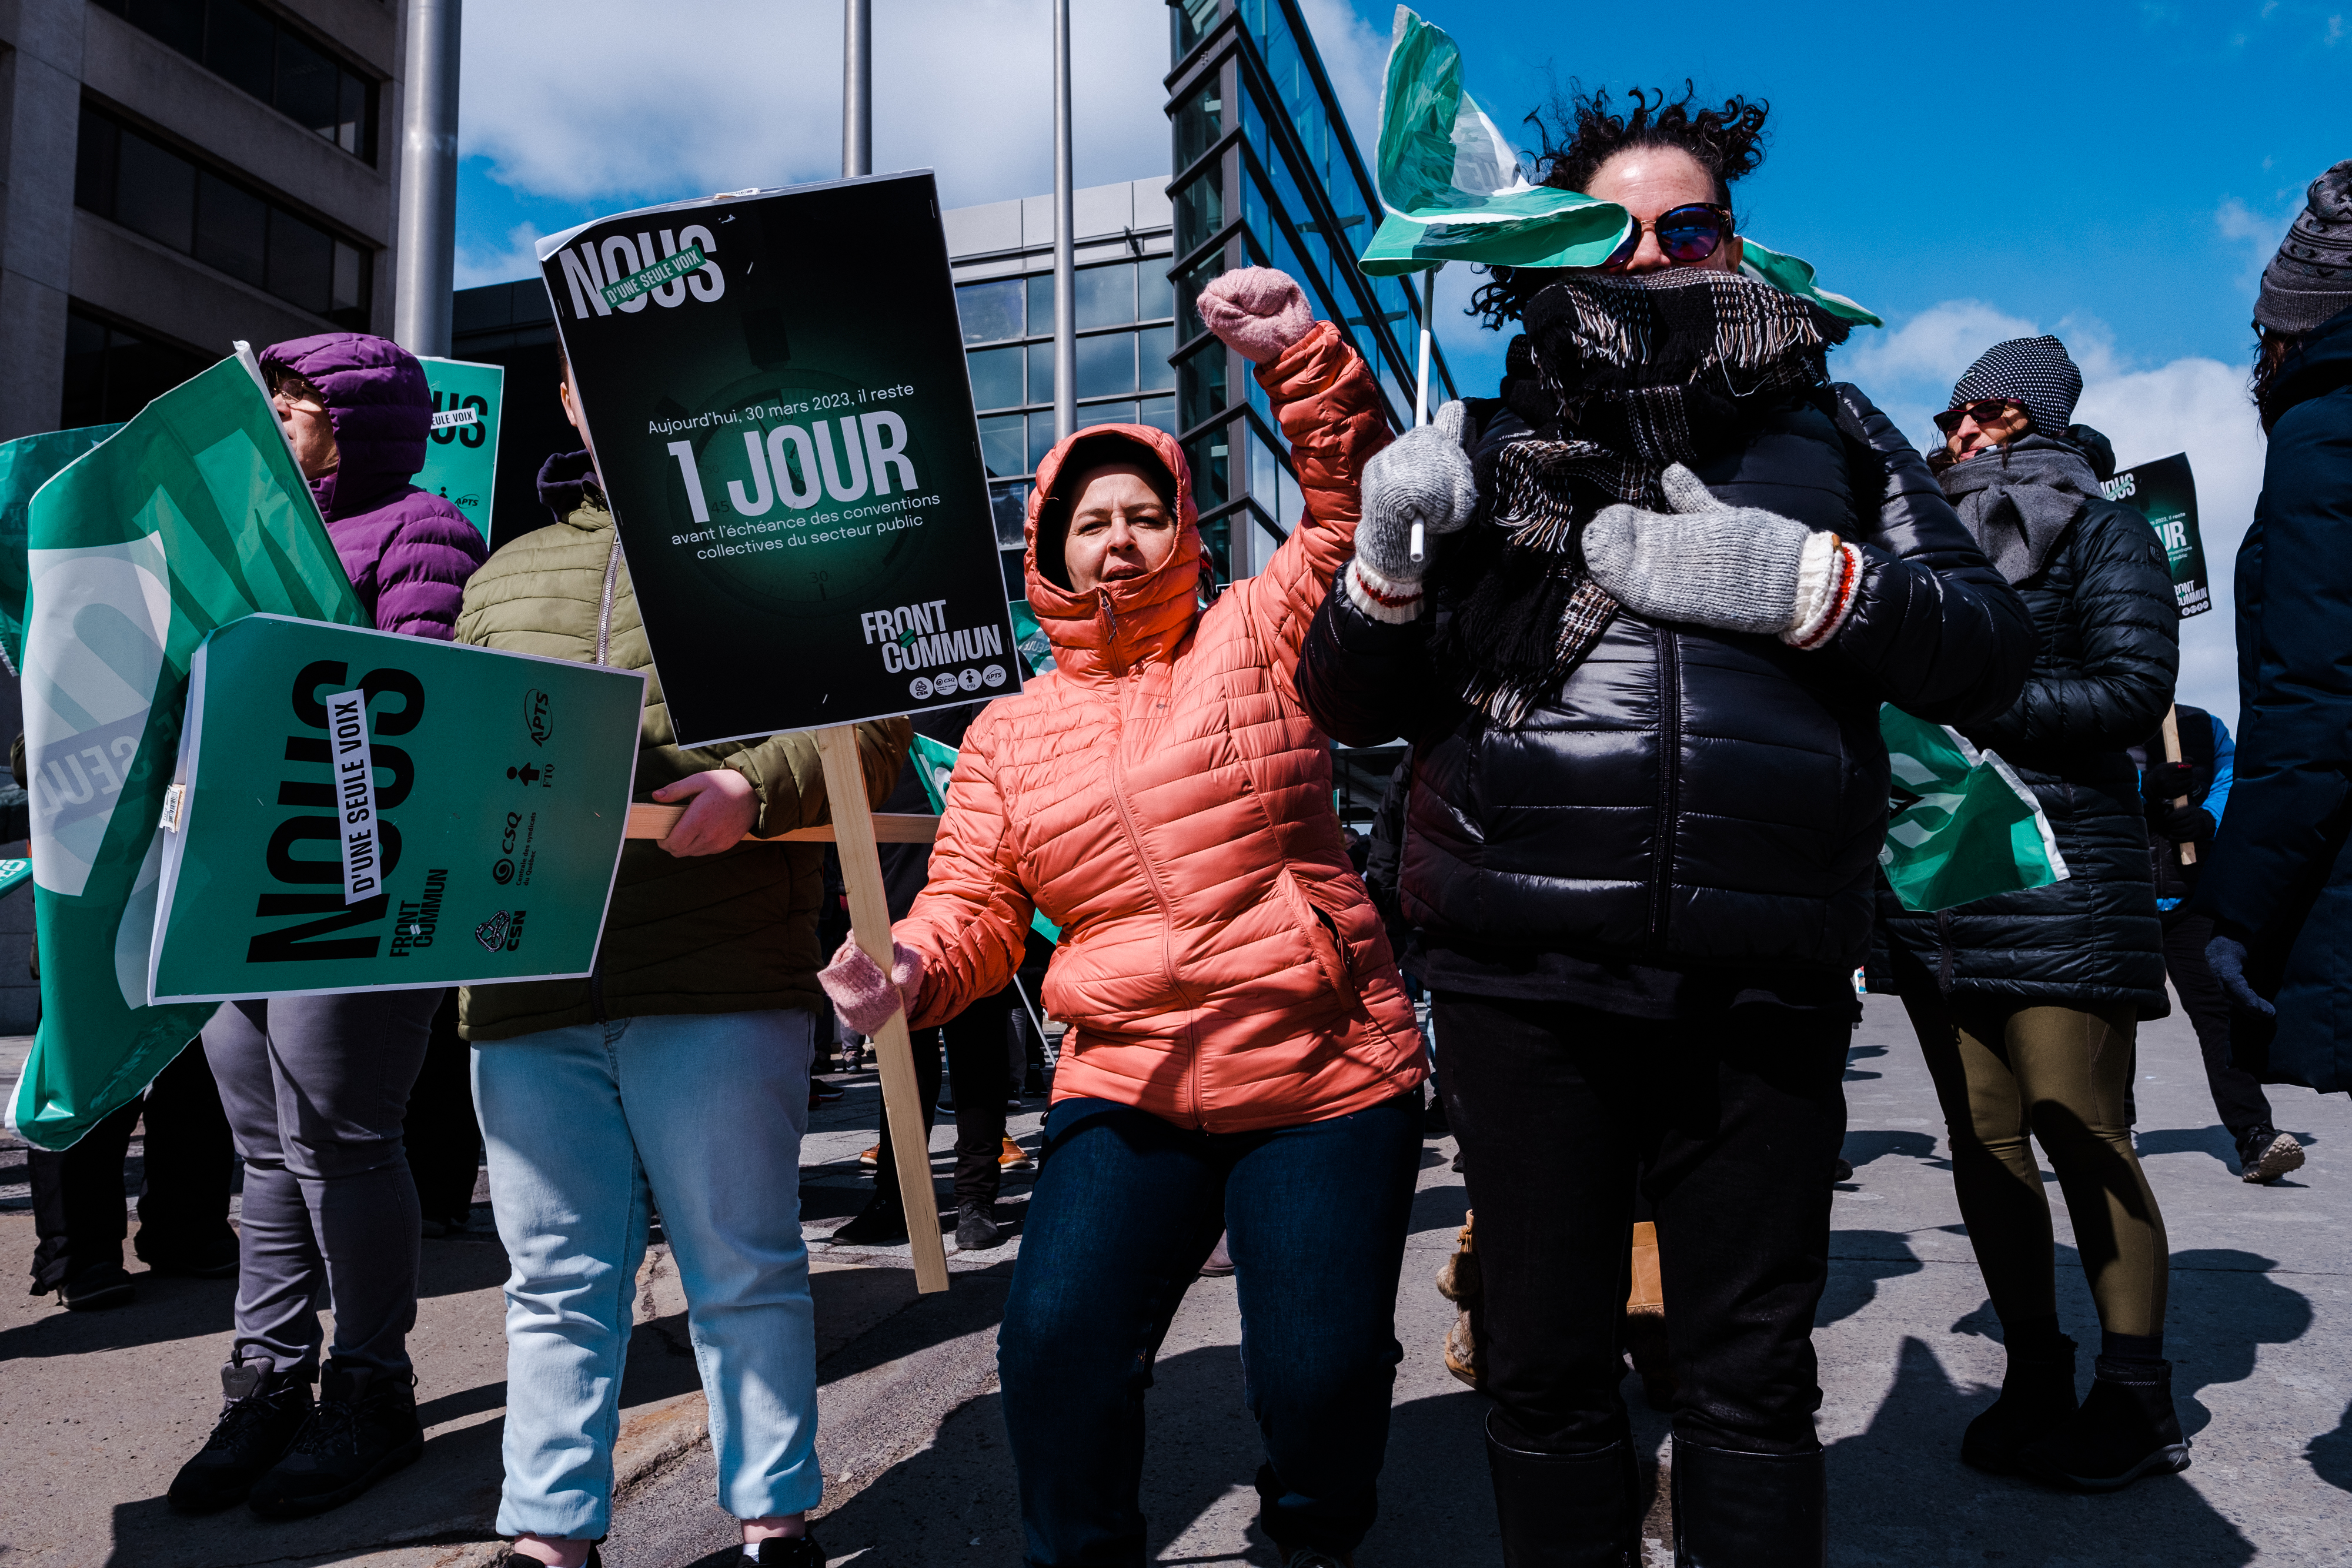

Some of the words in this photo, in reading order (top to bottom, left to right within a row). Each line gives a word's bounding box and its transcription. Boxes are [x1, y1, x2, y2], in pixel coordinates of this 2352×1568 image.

[559, 225, 725, 319] NOUS
[606, 279, 640, 304] D'UNE
[640, 263, 673, 287] SEULE
[672, 250, 700, 272] VOIX
[430, 390, 488, 449] US
[432, 414, 450, 426] EULE
[453, 411, 473, 422] VOIX
[746, 406, 764, 420] 30
[769, 402, 809, 417] mars
[813, 392, 854, 410] 2023,
[858, 389, 866, 403] il
[871, 384, 914, 401] reste
[667, 440, 710, 523] 1
[727, 410, 919, 516] JOUR
[455, 497, 479, 507] APTS
[671, 529, 716, 545] avant
[720, 516, 806, 539] l'échéance
[811, 510, 839, 524] des
[843, 495, 940, 519] conventions
[697, 537, 783, 560] collectives
[787, 533, 807, 547] du
[811, 525, 871, 543] secteur
[877, 515, 923, 536] public
[2154, 521, 2187, 551] UR
[2174, 580, 2194, 596] RONT
[861, 600, 946, 644] FRONT
[882, 624, 1003, 673] COMMUN
[334, 700, 363, 755] VOIX
[531, 691, 549, 748] APTS
[342, 758, 370, 824] SEULE
[543, 764, 556, 788] FTQ
[246, 660, 425, 963] NOUS
[502, 811, 522, 854] CSQ
[350, 828, 375, 895] D'UNE
[516, 858, 527, 886] Centrale
[527, 811, 536, 843] syndicats
[526, 850, 536, 876] Québec
[523, 877, 530, 886] du
[389, 900, 420, 957] FRONT
[413, 869, 448, 948] COMMUN
[506, 910, 527, 952] CSN
